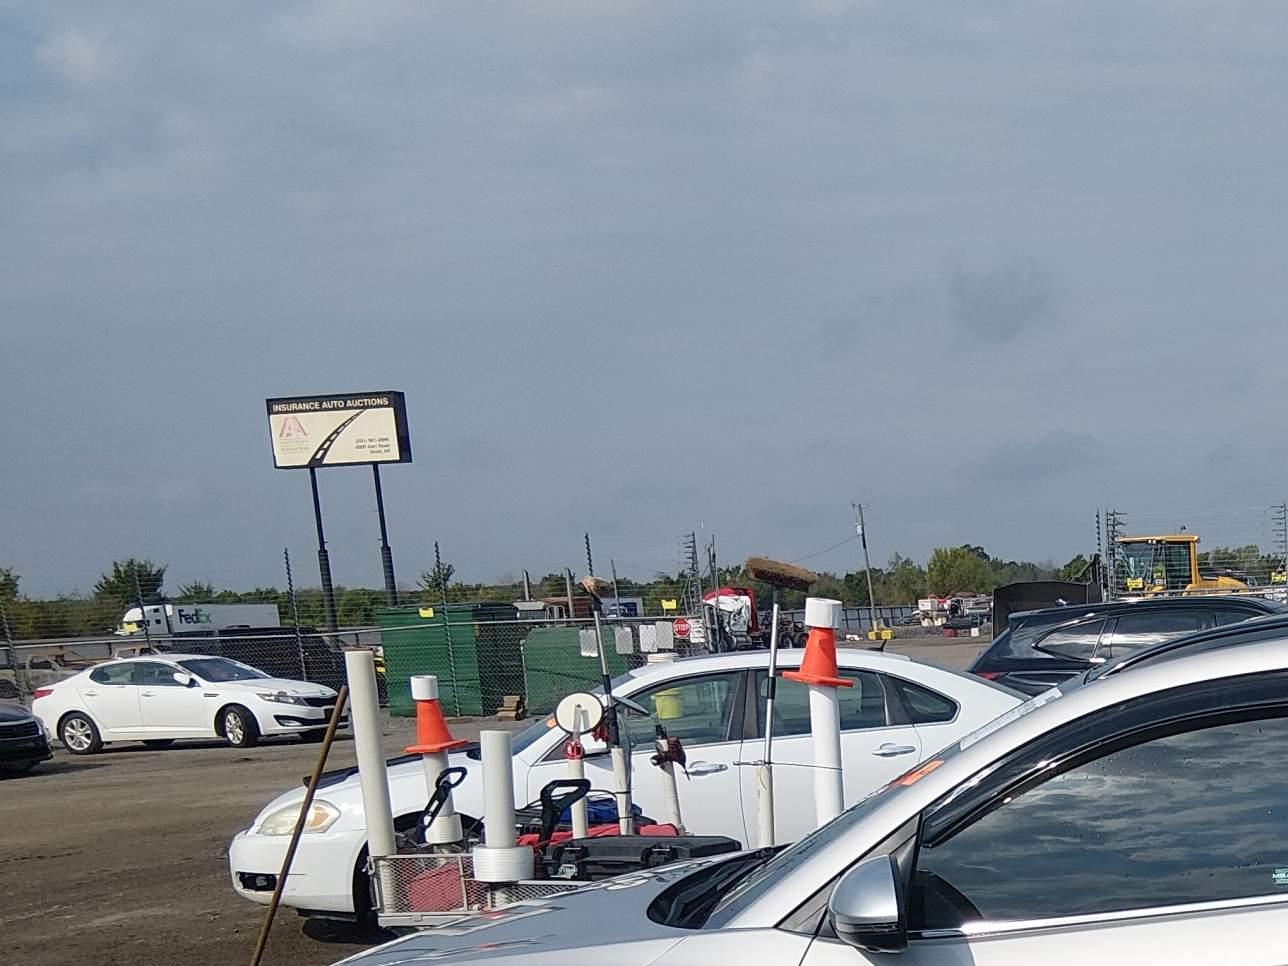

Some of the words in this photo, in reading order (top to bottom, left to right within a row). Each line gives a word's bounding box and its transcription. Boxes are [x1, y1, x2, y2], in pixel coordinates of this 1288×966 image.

[272, 401, 320, 412] INSURANCE
[322, 400, 345, 409] AUTO
[346, 397, 389, 407] AUCTIONS
[178, 608, 212, 624] FedEx
[674, 624, 689, 632] STOP
